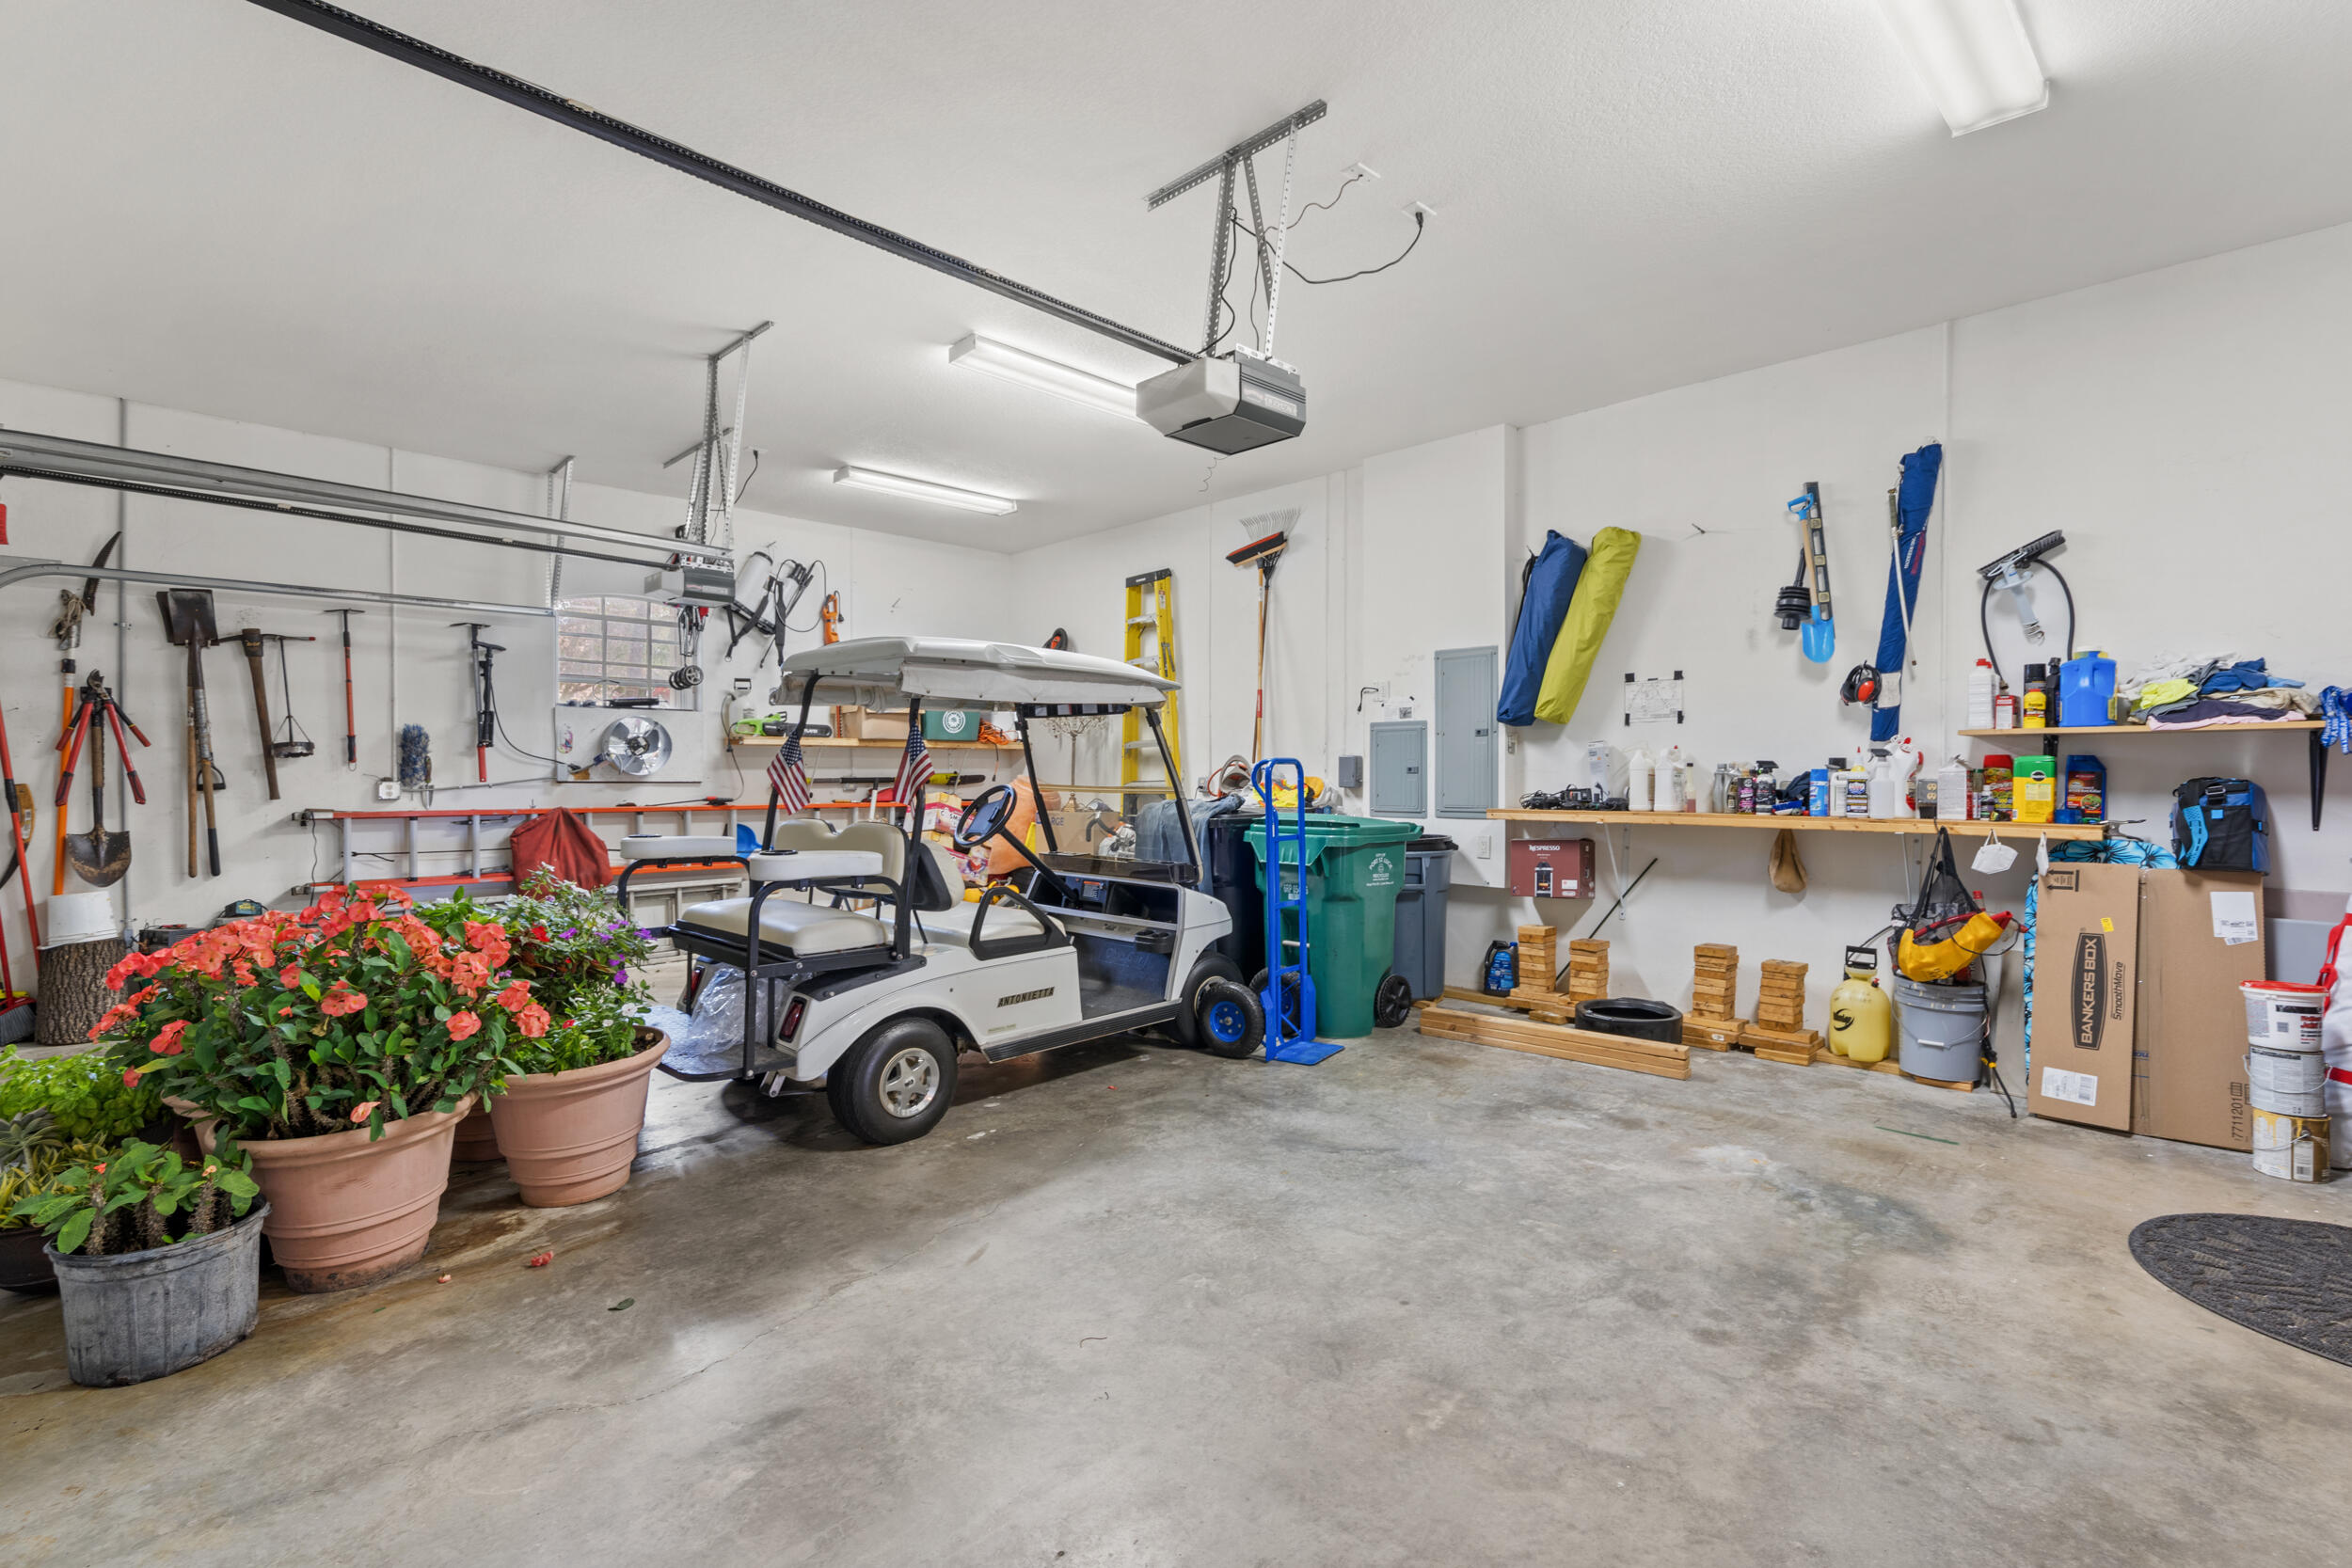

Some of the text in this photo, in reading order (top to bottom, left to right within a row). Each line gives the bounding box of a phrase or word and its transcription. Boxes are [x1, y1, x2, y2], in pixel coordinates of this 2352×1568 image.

[997, 986, 1055, 1007] ANTONIETTA
[2080, 938, 2098, 1044] BANKERS BOX
[2113, 961, 2123, 1021] SmoothMove
